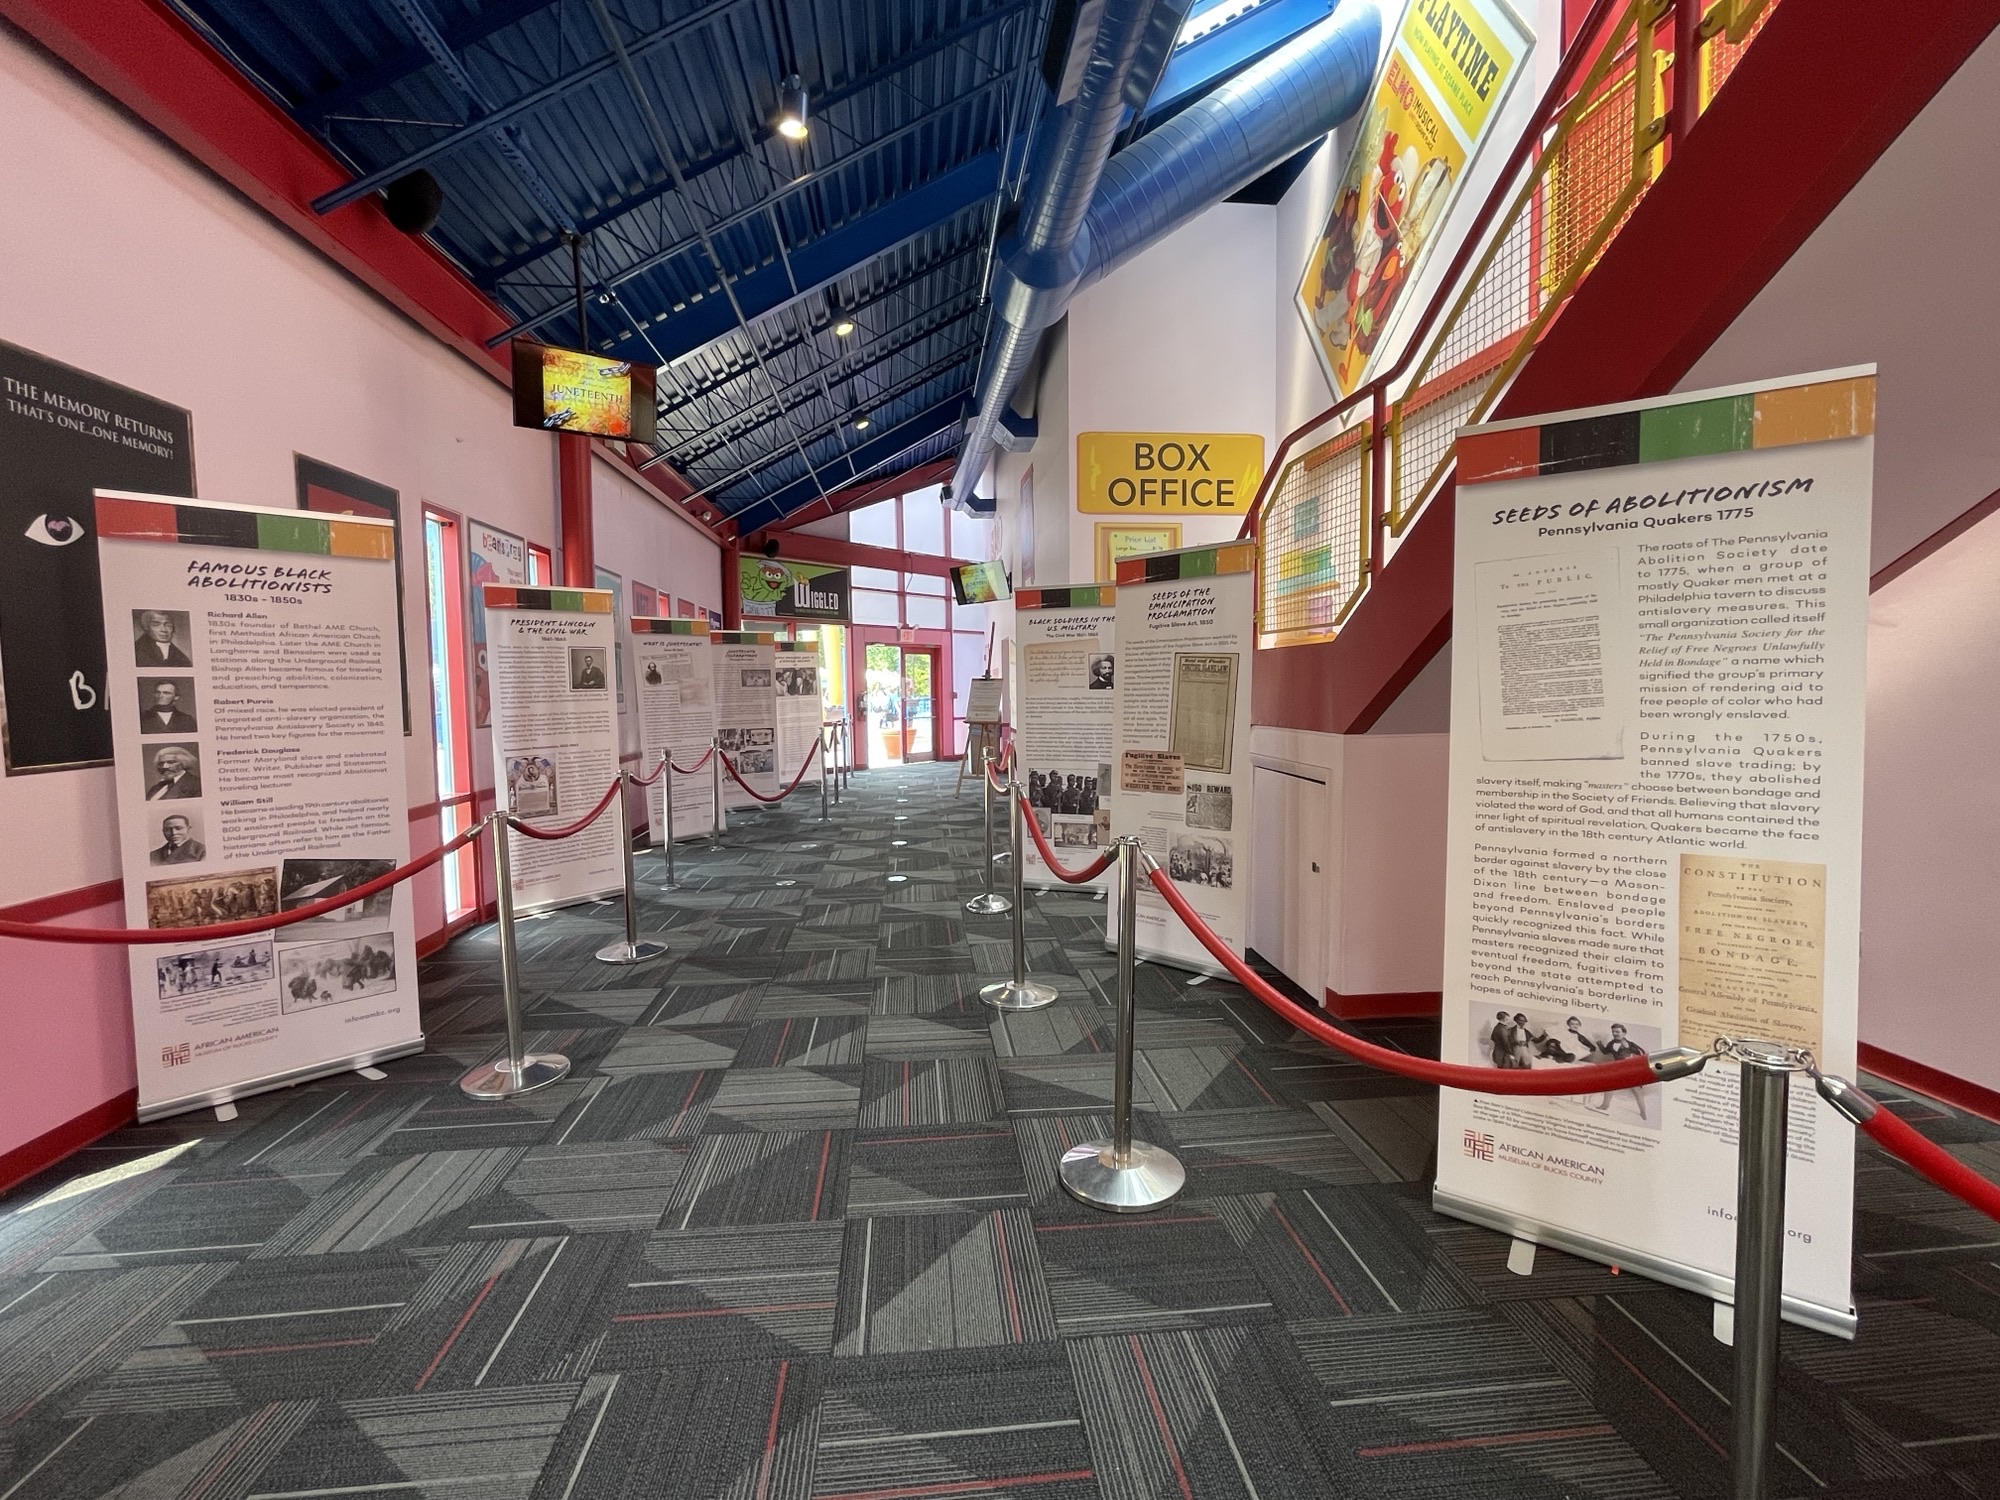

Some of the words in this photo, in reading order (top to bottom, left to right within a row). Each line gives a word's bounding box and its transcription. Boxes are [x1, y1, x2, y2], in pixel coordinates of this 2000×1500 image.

[1386, 60, 1415, 111] ELMO
[1443, 70, 1461, 98] SESAME
[1459, 92, 1474, 116] PLACE
[1414, 99, 1439, 143] MUSICAL
[551, 384, 623, 403] JUNETEENTH
[3, 376, 38, 400] THE
[44, 390, 110, 423] MEMORY
[114, 414, 173, 444] RETURNS
[6, 398, 54, 423] THAT'S
[122, 435, 173, 460] MEMORY!
[1135, 442, 1211, 472] BOX
[1108, 477, 1235, 507] OFFICE
[1492, 504, 1562, 525] SEEDS
[1568, 499, 1600, 518] OF
[1606, 478, 1814, 513] ABOLITIONISM
[1538, 518, 1638, 537] Pennsylvania
[1643, 513, 1712, 529] Quakers
[1716, 507, 1753, 520] 1775
[1637, 543, 1659, 553] The
[1661, 541, 1693, 551] roots
[1695, 538, 1709, 548] of
[1710, 537, 1735, 546] The
[1738, 529, 1828, 544] Pennsylvania
[1637, 553, 1705, 565] Abolition
[1716, 548, 1777, 560] Society
[1790, 544, 1828, 554] date
[1697, 564, 1734, 574] when
[1759, 560, 1803, 572] group
[1811, 556, 1828, 567] of
[187, 561, 268, 576] FAMOUS
[273, 566, 332, 581] BLACK
[187, 576, 333, 594] ABOLITIONISTS
[1152, 591, 1177, 601] SEEDS
[1180, 589, 1191, 598] OF
[1193, 587, 1210, 596] THE
[1638, 591, 1711, 604] Philadelphia
[1713, 590, 1756, 600] tavern
[1758, 588, 1773, 597] to
[1775, 586, 1826, 596] discuss
[224, 593, 258, 602] 1830s
[270, 595, 302, 605] 1850s
[1149, 597, 1215, 610] EMANCIPATION
[1638, 606, 1711, 616] antislavery
[1794, 598, 1826, 608] This
[1054, 616, 1089, 624] SOLDIERS
[1147, 607, 1216, 620] PROCLAMATION
[1638, 619, 1669, 629] small
[1670, 616, 1748, 629] organization
[1750, 613, 1790, 624] called
[1792, 612, 1826, 622] itself
[69, 670, 109, 710] B
[1640, 731, 1695, 743] During
[1714, 732, 1743, 742] the
[1206, 785, 1232, 796] REWARD
[1684, 868, 1821, 888] CONSTITUTION
[1473, 878, 1506, 893] Dixon
[1514, 881, 1536, 895] line
[1543, 884, 1598, 897] between
[1606, 890, 1666, 906] bondage
[1685, 925, 1724, 937] FREE
[1470, 981, 1501, 994] hopes
[1503, 988, 1515, 996] of
[1516, 991, 1568, 1007] achieving
[194, 1037, 232, 1050] AFRICAN
[234, 1026, 279, 1042] AMERICAN
[1498, 1154, 1530, 1167] MUSEUM
[1543, 1164, 1568, 1176] BUCKS
[1569, 1171, 1603, 1185] COUNTY
[1499, 1143, 1544, 1161] AFRICAN
[1546, 1154, 1605, 1176] AMERICAN
